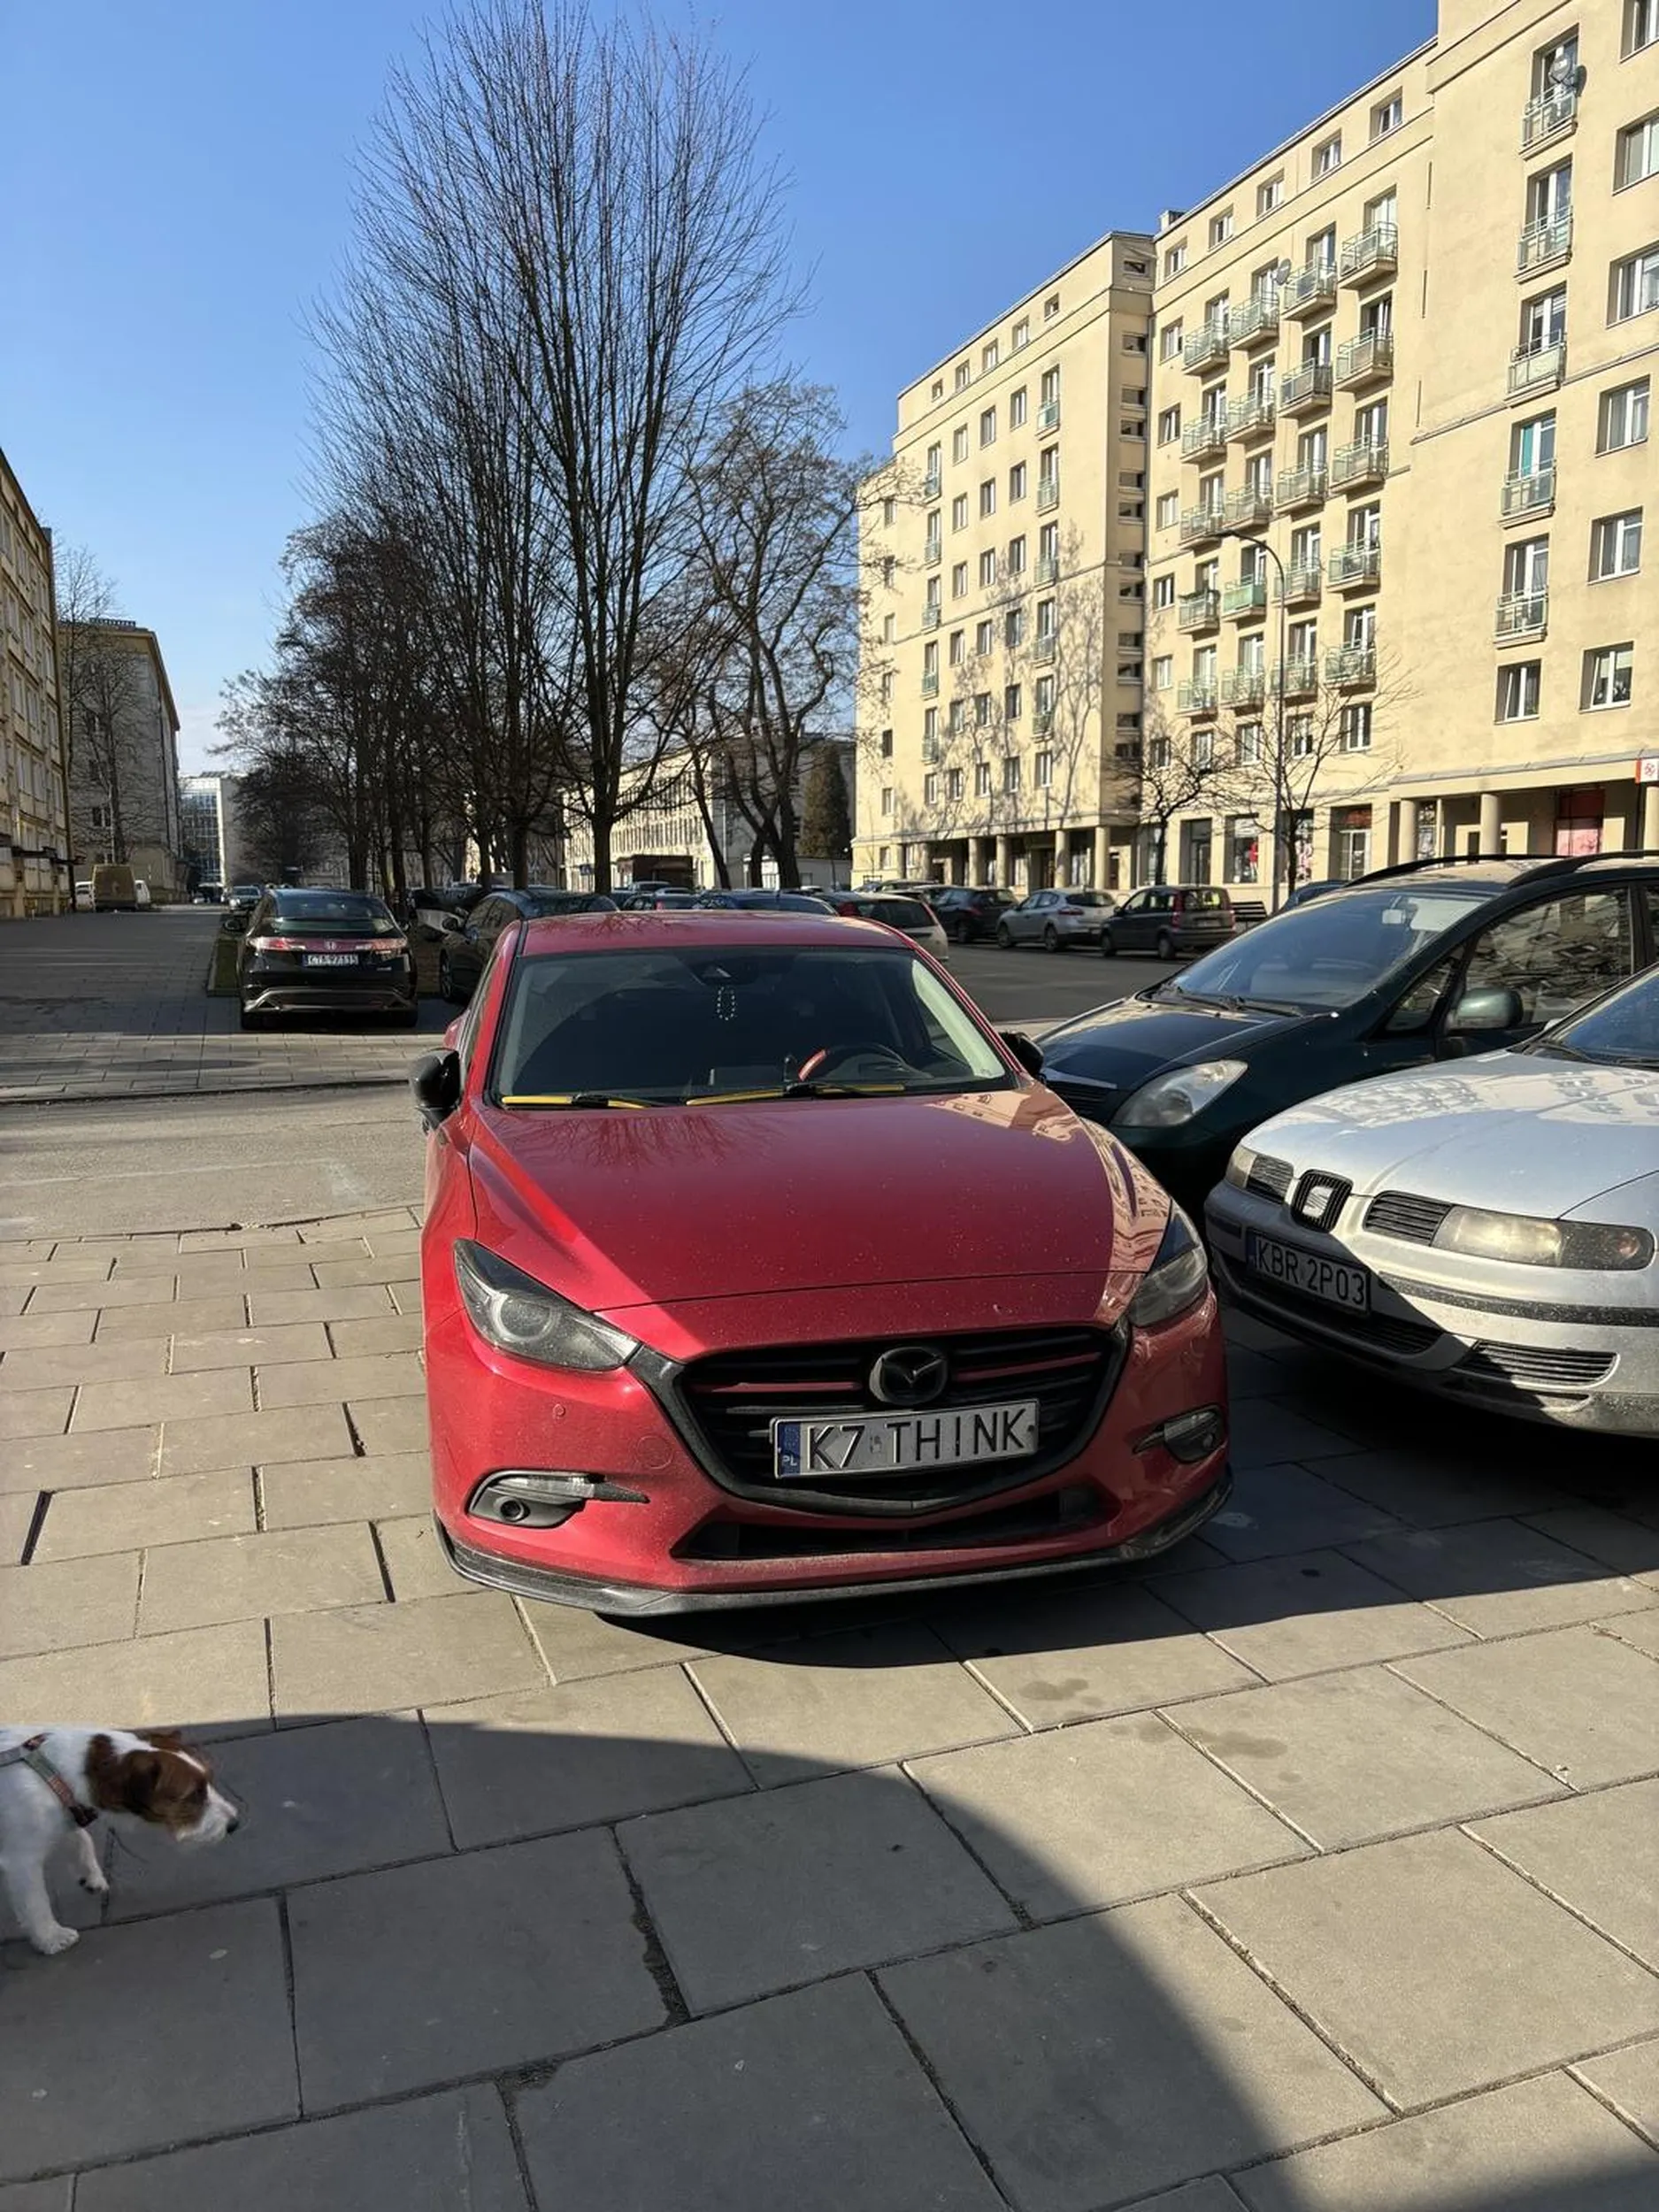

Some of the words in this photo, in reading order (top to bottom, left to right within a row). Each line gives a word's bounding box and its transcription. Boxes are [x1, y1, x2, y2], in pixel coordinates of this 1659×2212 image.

[1257, 1240, 1299, 1284] KBR
[1307, 1258, 1364, 1304] 2P03
[808, 1425, 865, 1470] K7
[886, 1409, 1026, 1463] THINK
